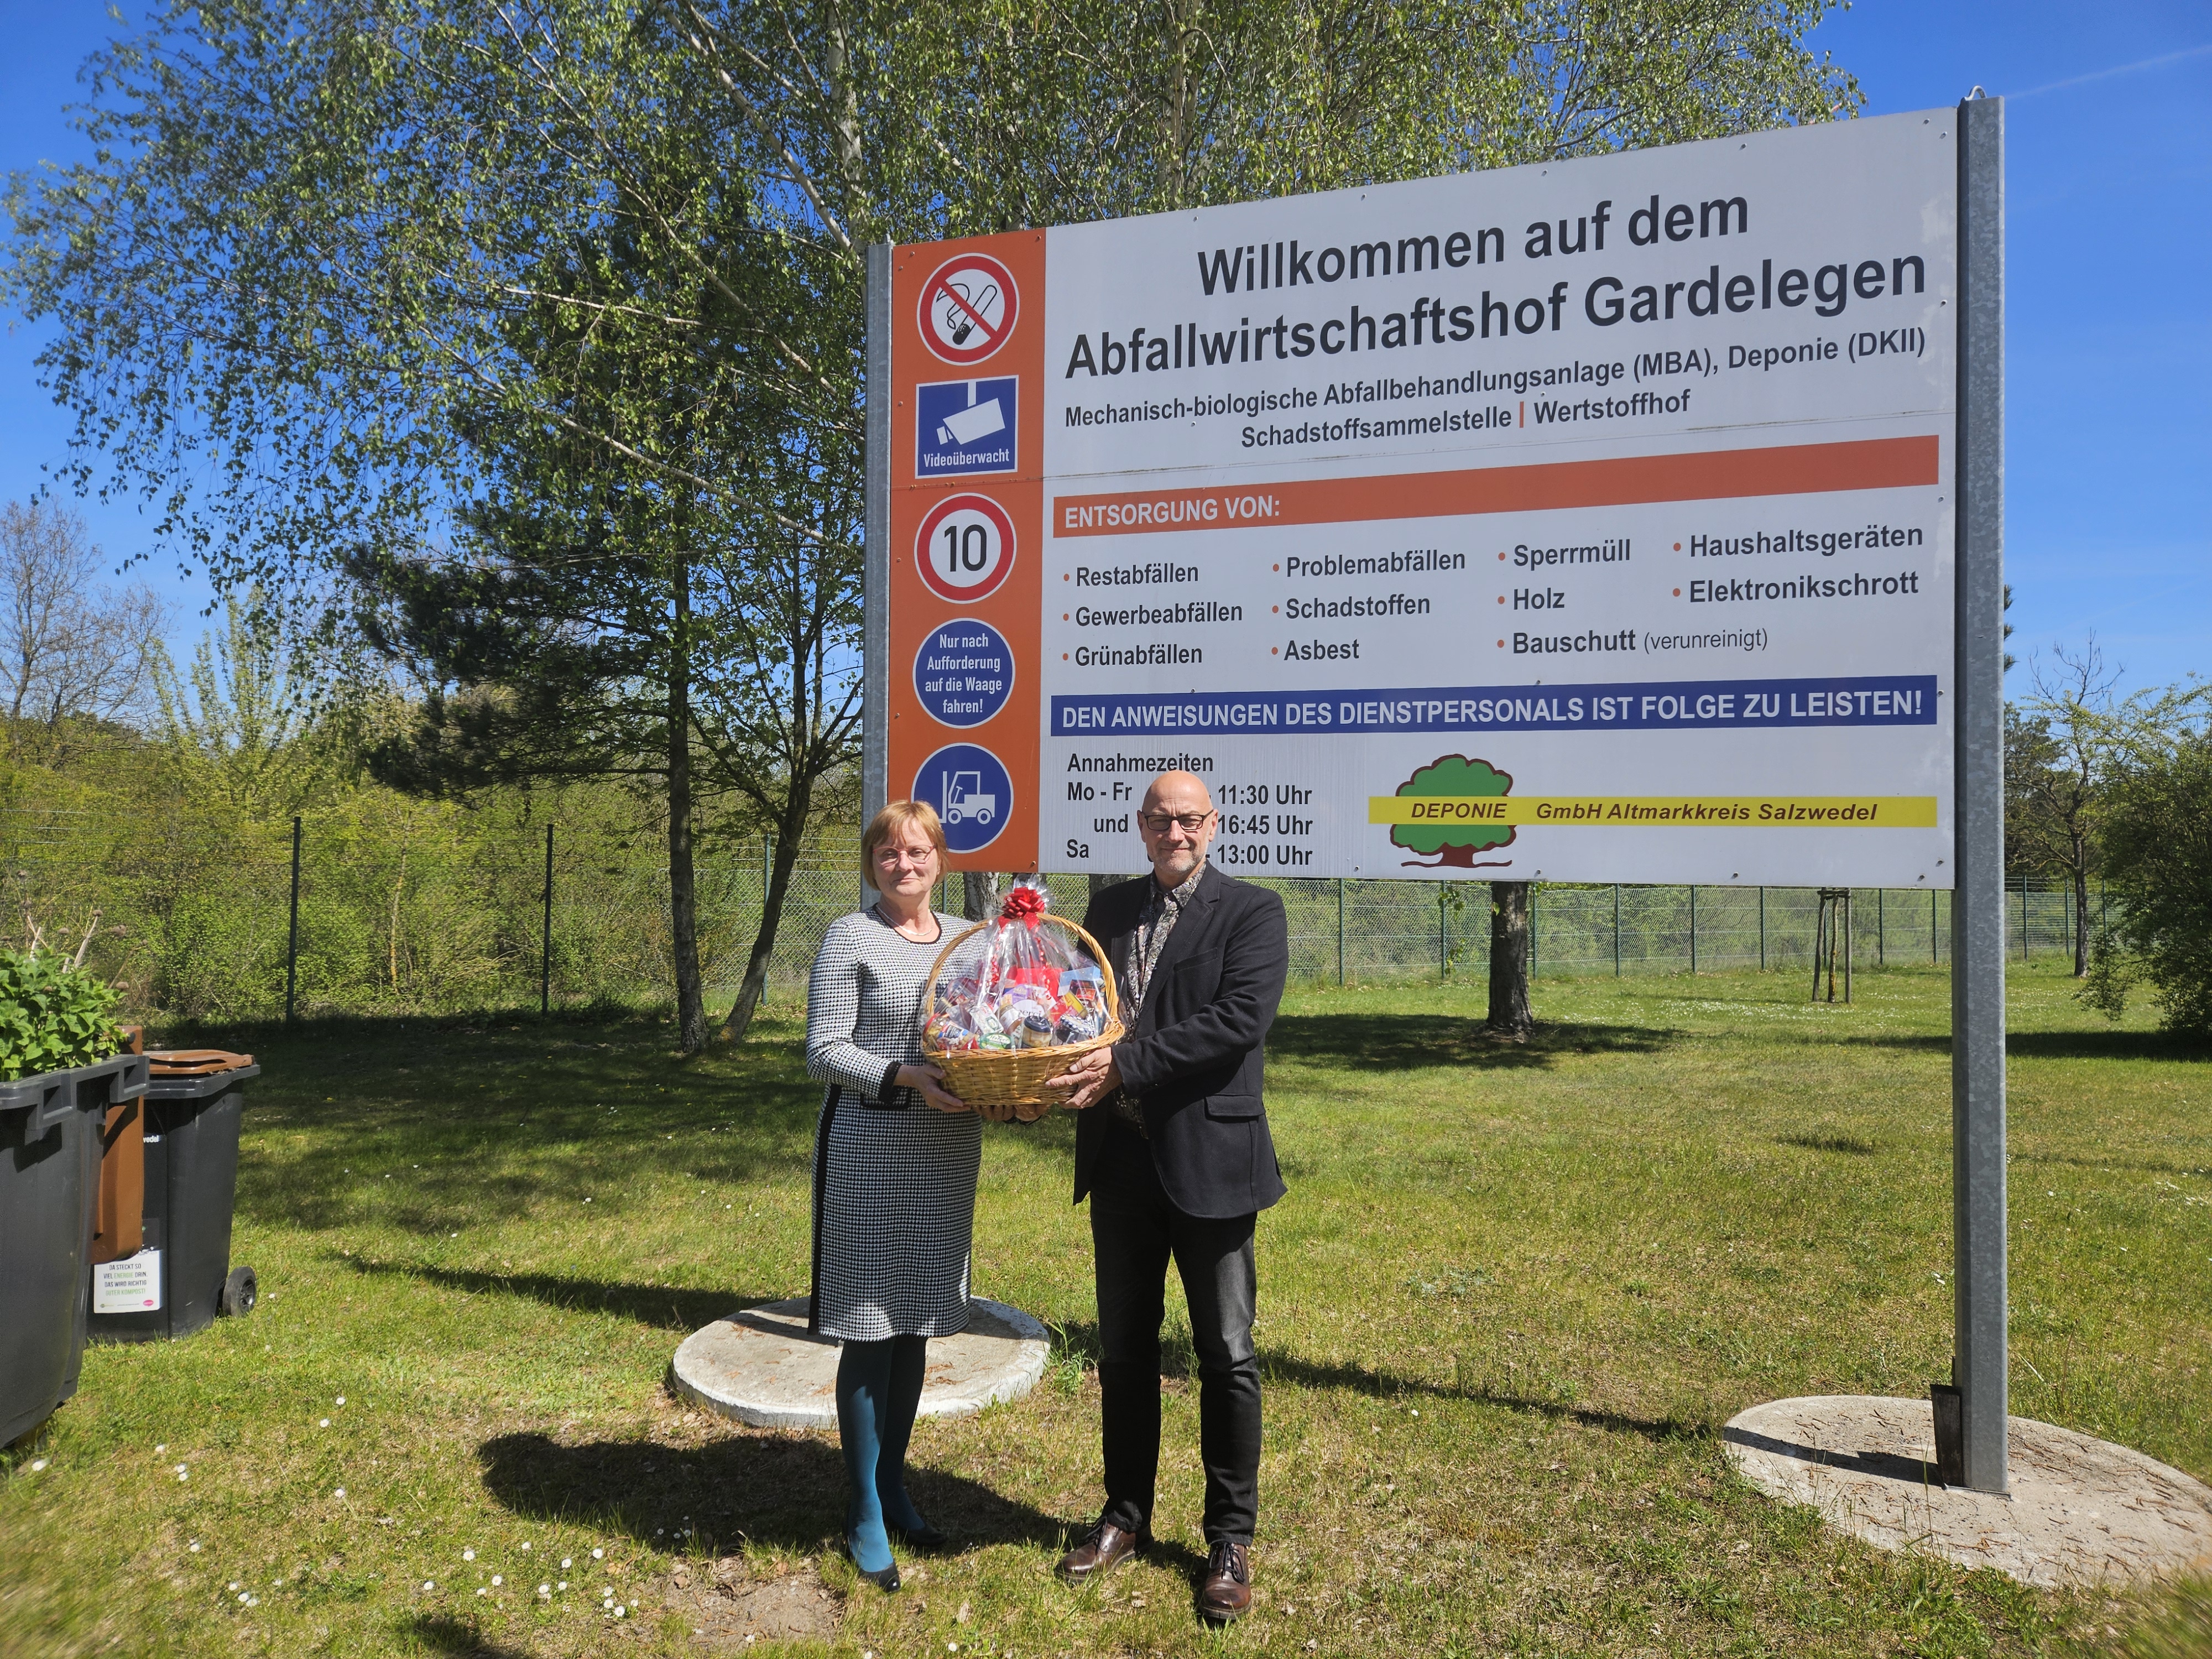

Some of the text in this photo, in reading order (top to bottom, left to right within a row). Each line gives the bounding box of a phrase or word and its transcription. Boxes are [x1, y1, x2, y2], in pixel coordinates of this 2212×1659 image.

[1197, 194, 1747, 296] Willkommen auf dem
[1065, 255, 1924, 379] Abfallwirtschaftshof Gardelegen
[1066, 327, 1925, 427] Mechanisch-biologische Abfallbehandlungsanlage (MBA), Deponie (DKII)
[1241, 405, 1511, 448] Schadstoffsammelstelle
[1533, 388, 1691, 424] Wertstoffhof
[924, 448, 1010, 467] Videoüberwacht
[1066, 495, 1280, 528] ENTSORGUNG VON:
[944, 524, 987, 572] 10
[1691, 524, 1923, 557] Haushaltsgeräten
[1287, 549, 1465, 577] Problemabfällen
[1514, 539, 1630, 571] Sperrmüll
[1077, 562, 1198, 587] Restabfällen
[1690, 571, 1919, 603] Elektronikschrott
[1286, 593, 1430, 619] Schadstoffen
[1514, 587, 1565, 610] Holz
[1076, 601, 1242, 627] Gewerbeabfällen
[940, 633, 988, 649] Nur nach
[1284, 639, 1359, 661] Asbest
[1513, 628, 1767, 655] Bauschutt (verunreinigt)
[927, 655, 1000, 672] Aufforderung
[1075, 644, 1202, 666] Grünabfällen
[925, 677, 1002, 695] auf die Waage
[942, 698, 983, 713] fahren!
[1063, 690, 1922, 728] DEN ANWEISUNGEN DES DIENSTPERSONALS IST FOLGE ZU LEISTEN!
[1067, 753, 1213, 772] Annahmezeiten
[1067, 781, 1094, 801] Mo
[1113, 782, 1133, 801] Fr
[1218, 785, 1269, 805] 11:30
[1276, 785, 1313, 805] Uhr
[1094, 813, 1313, 835] und 16:45 Uhr
[1411, 803, 1878, 820] DEPONIE GmbH Altmarkkreis Salzwedel
[1066, 839, 1089, 858] Sa
[1217, 844, 1269, 865] 13:00
[1276, 845, 1313, 865] Uhr
[1019, 1010, 1042, 1018] erci
